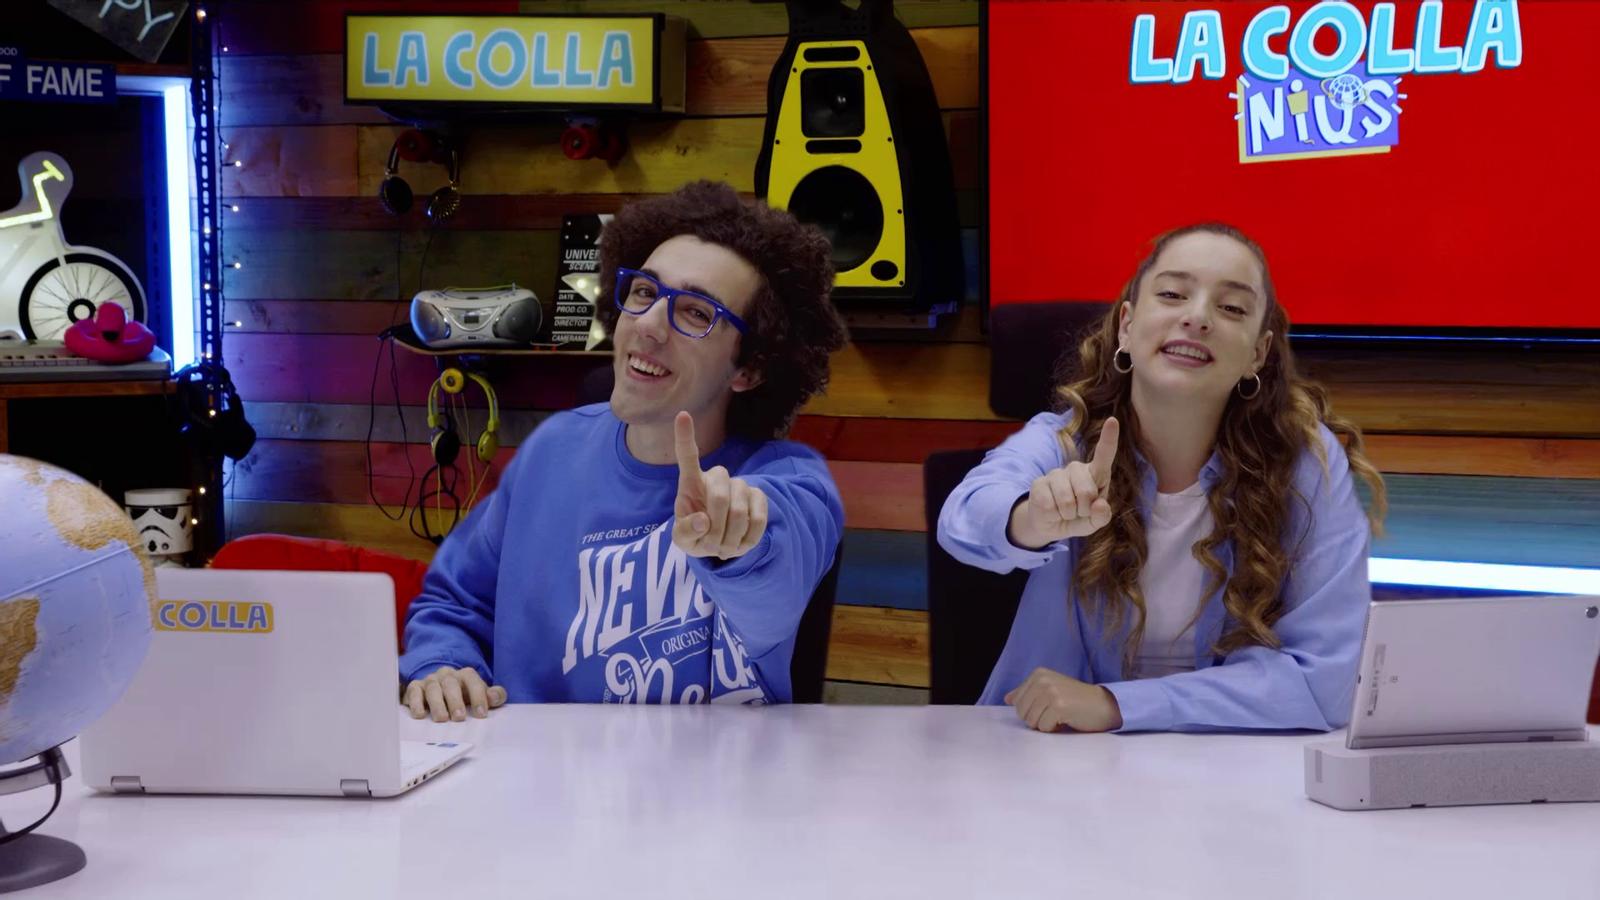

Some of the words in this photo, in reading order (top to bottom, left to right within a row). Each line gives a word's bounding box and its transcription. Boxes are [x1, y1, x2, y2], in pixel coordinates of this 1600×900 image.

[1129, 10, 1227, 83] LA
[1239, 0, 1523, 80] COLLA
[363, 31, 430, 89] LA
[443, 27, 635, 90] COLLA
[26, 65, 104, 97] FAME
[568, 262, 596, 271] SCENE
[554, 319, 588, 327] DIRECTOR
[581, 531, 605, 545] THE
[605, 526, 643, 539] GREAT
[159, 602, 269, 630] COLLA
